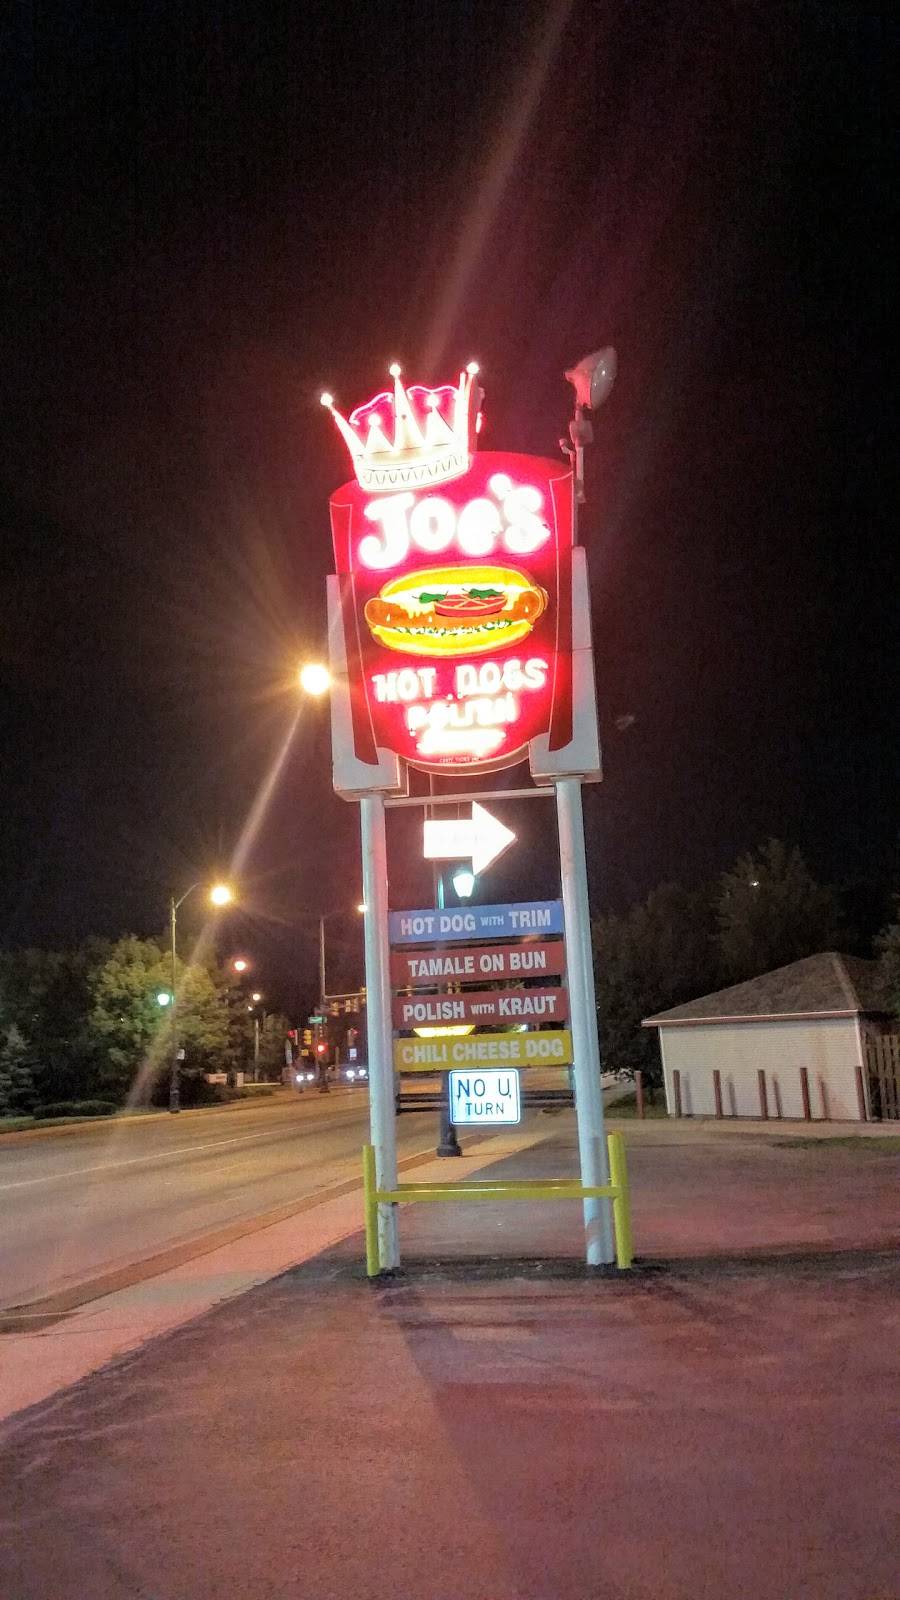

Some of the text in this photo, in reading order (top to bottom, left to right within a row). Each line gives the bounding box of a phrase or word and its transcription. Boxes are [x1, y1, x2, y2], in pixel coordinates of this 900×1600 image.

[371, 657, 549, 702] HOT DOGS
[400, 909, 551, 936] HOT DOG WITH TRIM
[407, 951, 546, 977] TAMALE ON BUN
[403, 995, 557, 1022] POLISH WITH KRAUT
[402, 1038, 564, 1064] CHILI CHEESE DOG
[457, 1078, 510, 1098] NO U
[465, 1102, 505, 1116] TURN
